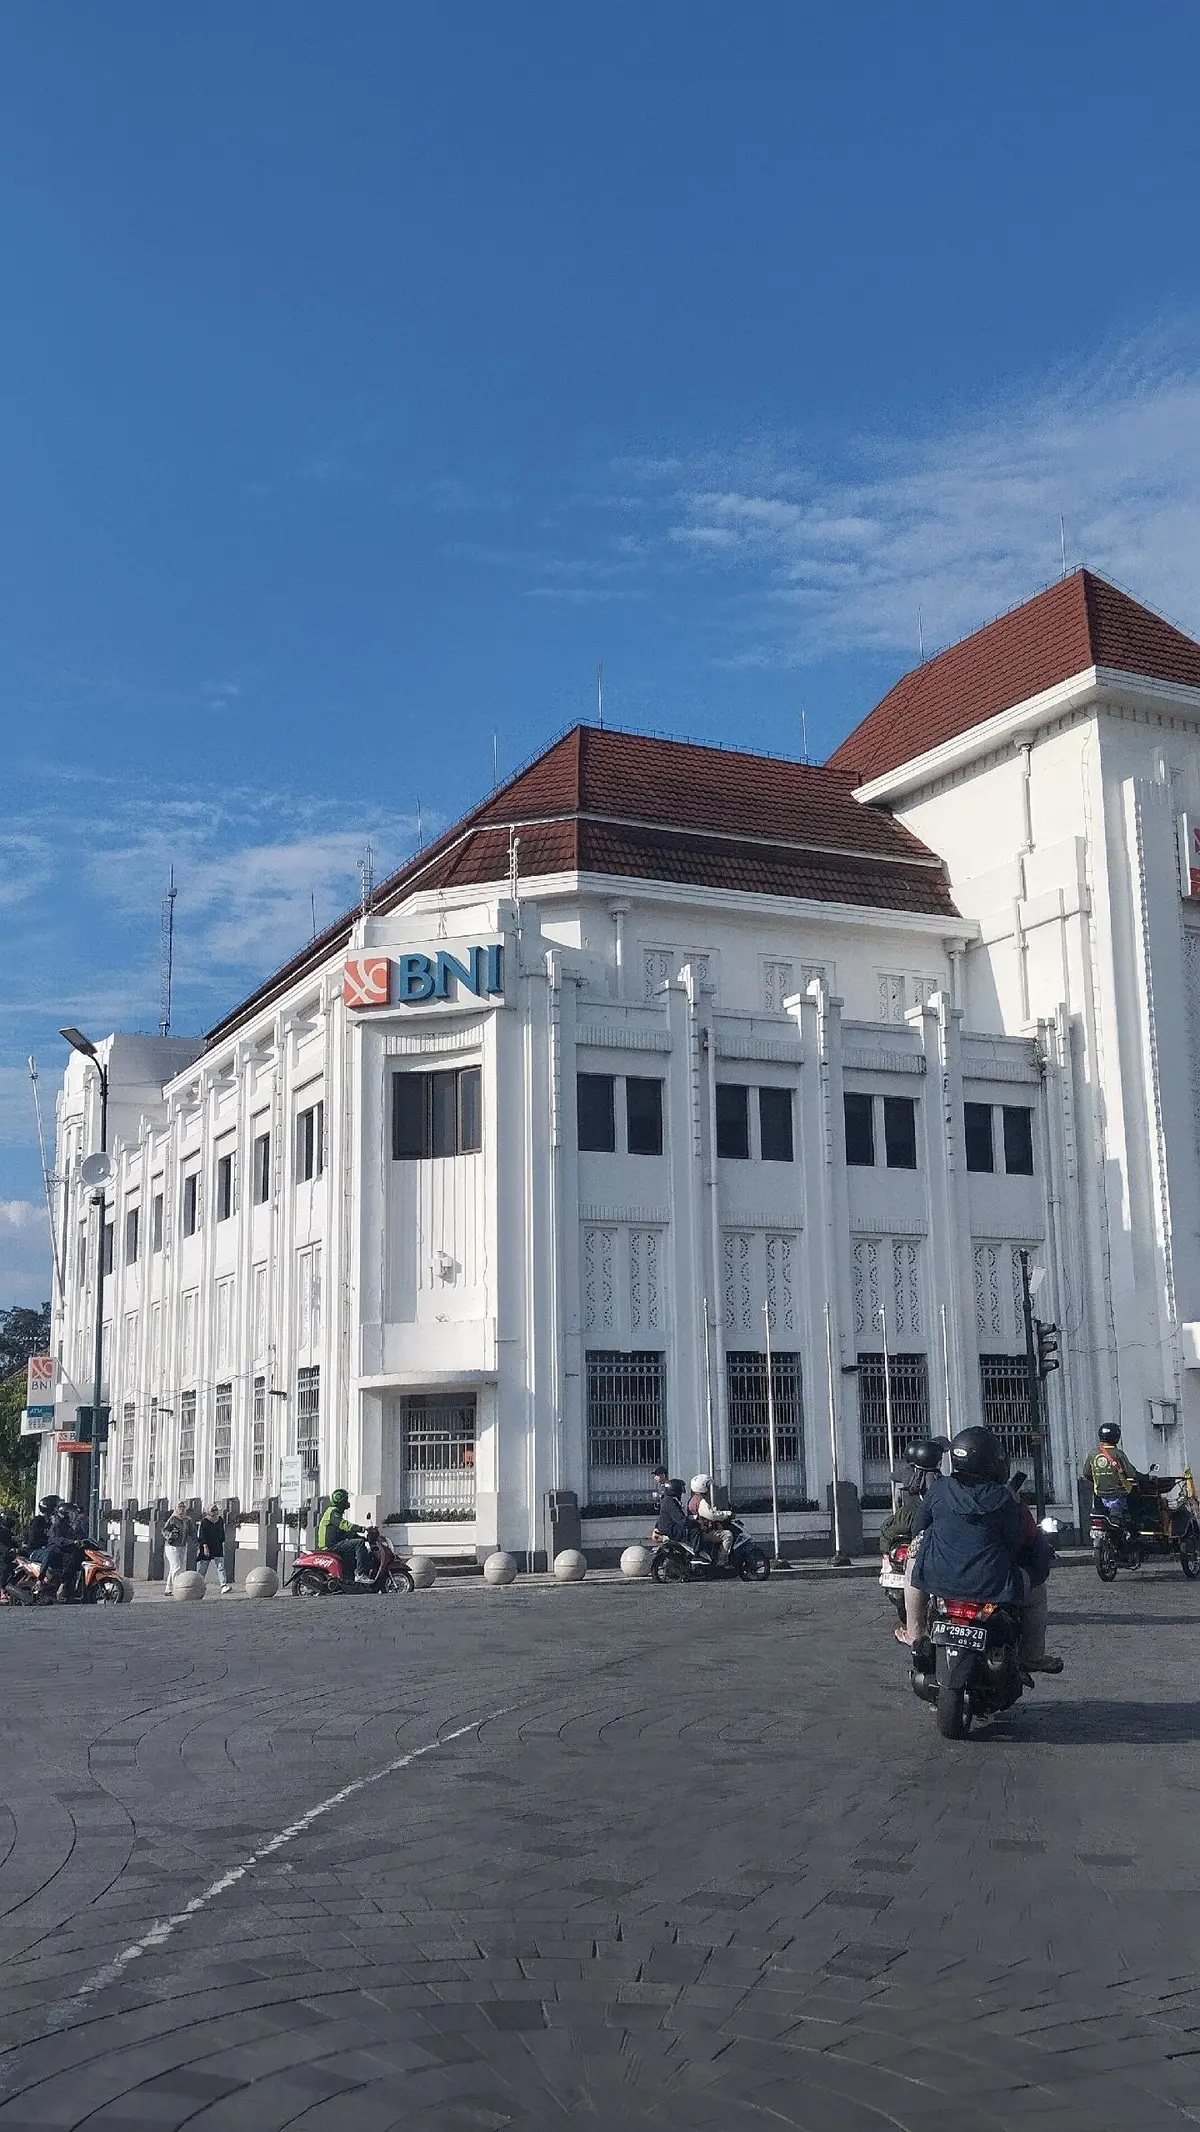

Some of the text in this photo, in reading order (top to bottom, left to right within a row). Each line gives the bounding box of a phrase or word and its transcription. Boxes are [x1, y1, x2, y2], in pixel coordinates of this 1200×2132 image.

[398, 944, 504, 1002] BNI
[32, 1381, 52, 1390] BNI
[935, 1624, 946, 1633] AB
[950, 1626, 971, 1637] 2983
